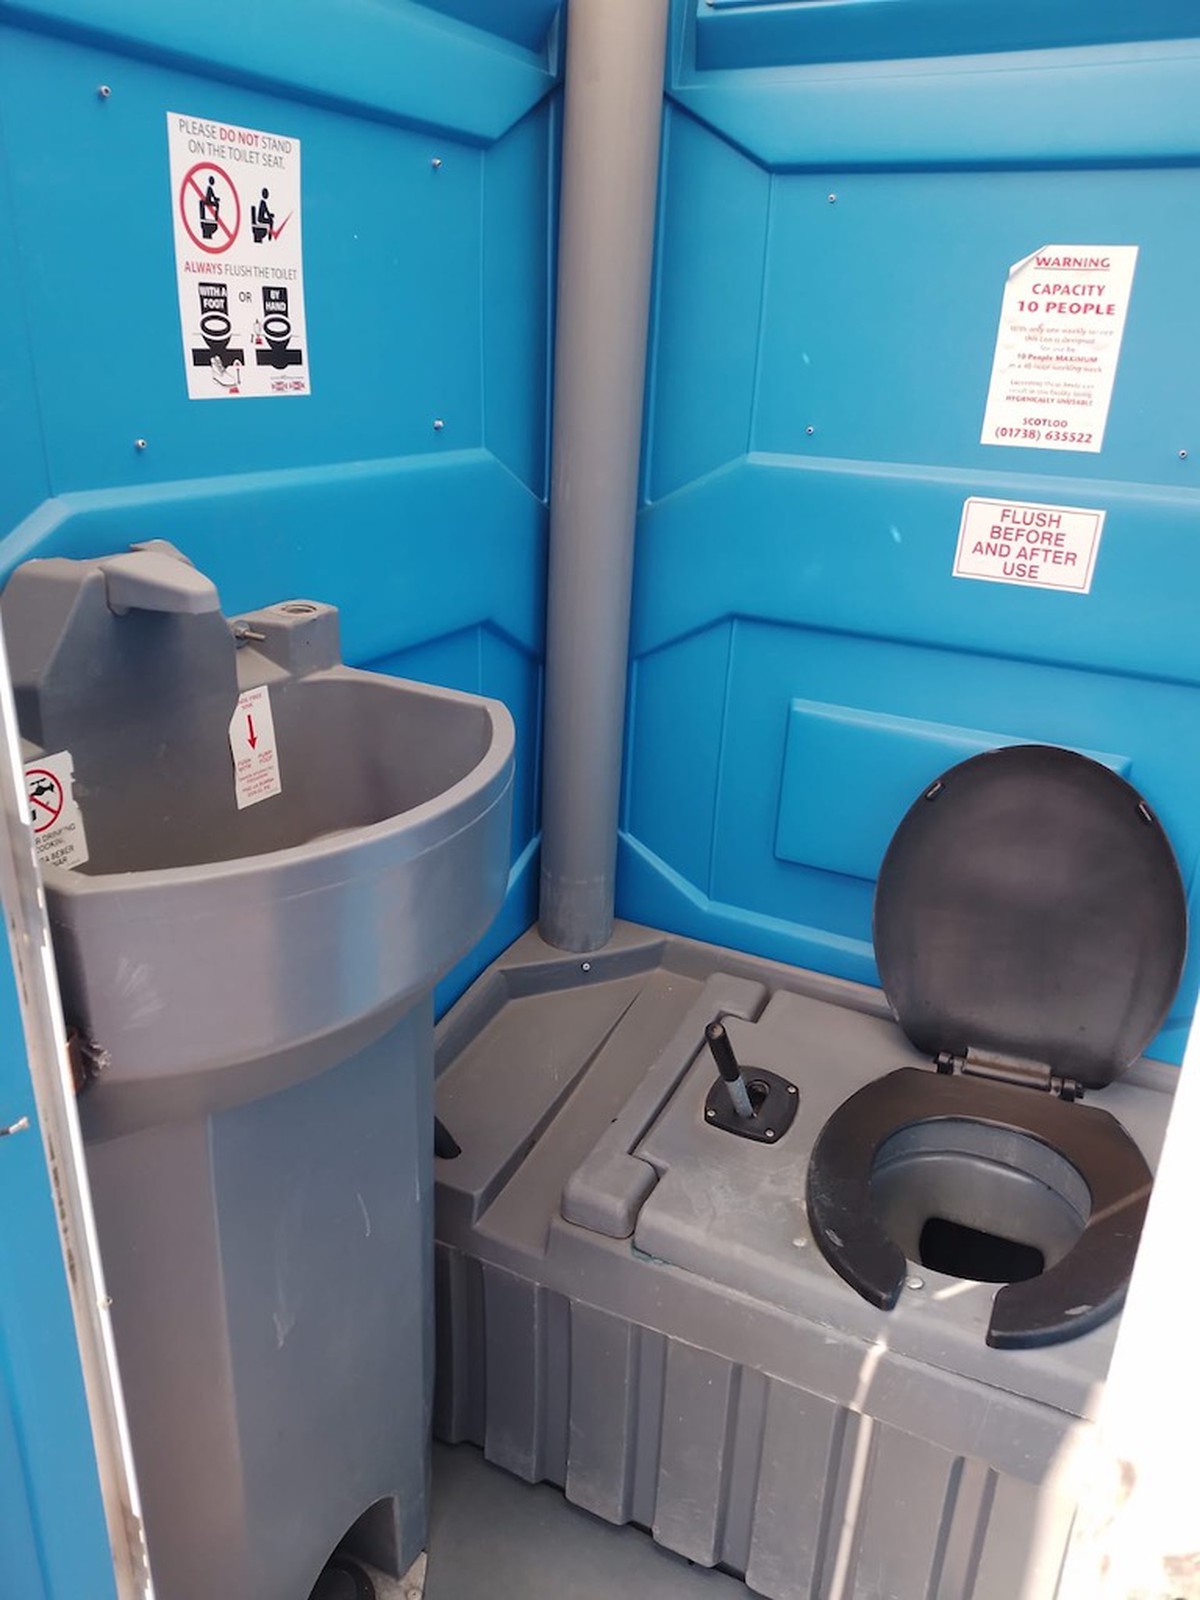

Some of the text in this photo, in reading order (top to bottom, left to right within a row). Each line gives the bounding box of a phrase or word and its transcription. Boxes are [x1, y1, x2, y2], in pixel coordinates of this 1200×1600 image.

[178, 118, 293, 155] PLEASE DO NOT STAND
[188, 138, 206, 156] ON
[207, 142, 227, 160] THE
[228, 146, 261, 166] TOILET
[1034, 256, 1111, 269] WARNING
[184, 261, 298, 281] ALWAYS FLUSH THE TOILET
[199, 285, 228, 297] WITH A
[239, 291, 253, 303] OR
[269, 289, 281, 301] BY
[1031, 282, 1107, 297] CAPACITY
[203, 297, 225, 310] FOOT
[265, 300, 287, 313] HAND
[1017, 300, 1117, 316] 10 PEOPLE
[1022, 416, 1068, 428] SCOTLOO
[994, 426, 1093, 444] (01738) 635522
[1000, 508, 1062, 529] FLUSH
[990, 525, 1067, 548] BEFORE
[971, 541, 1078, 567] AND AFTER
[1002, 562, 1040, 580] USE
